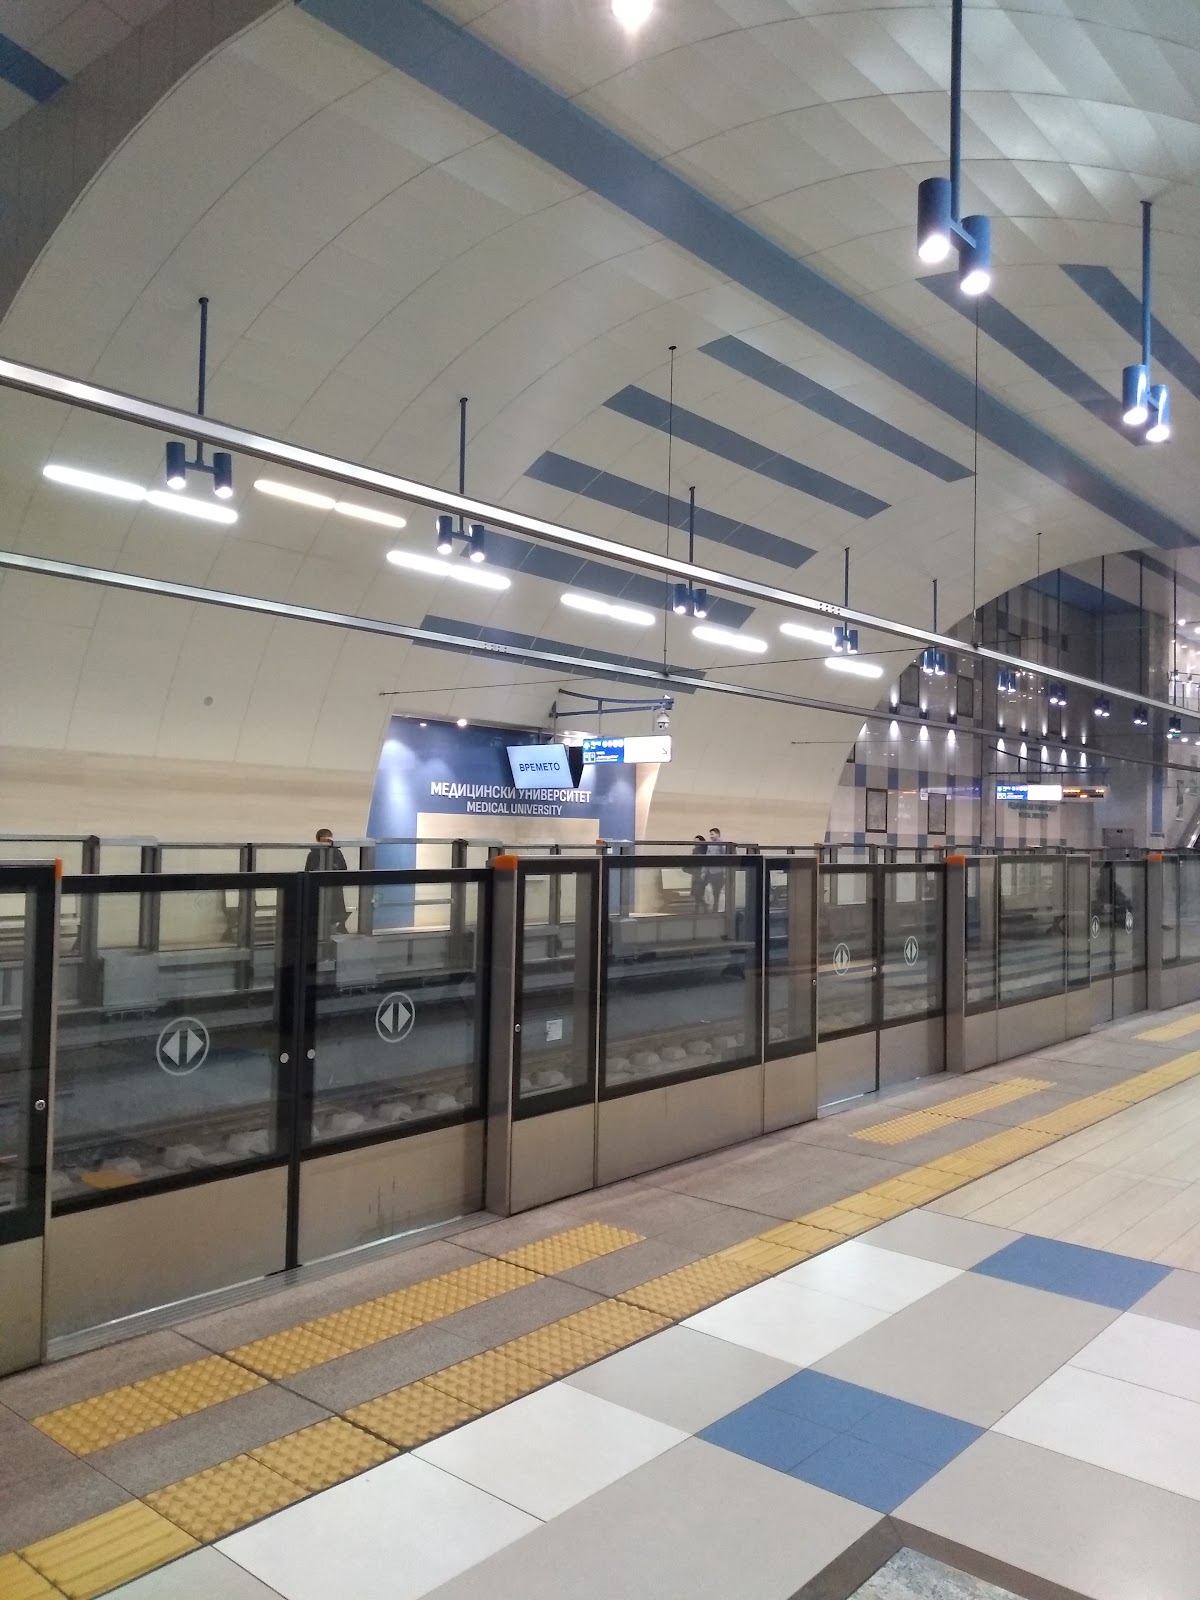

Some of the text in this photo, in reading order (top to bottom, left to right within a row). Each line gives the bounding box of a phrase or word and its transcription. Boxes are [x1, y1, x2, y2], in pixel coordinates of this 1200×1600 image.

[518, 761, 561, 772] ВРЕМЕТО
[430, 781, 592, 803] МЕДИЦИНСКИ УНИВЕРСИТЕТ
[466, 801, 563, 816] MEDICAL UNIVERSITY
